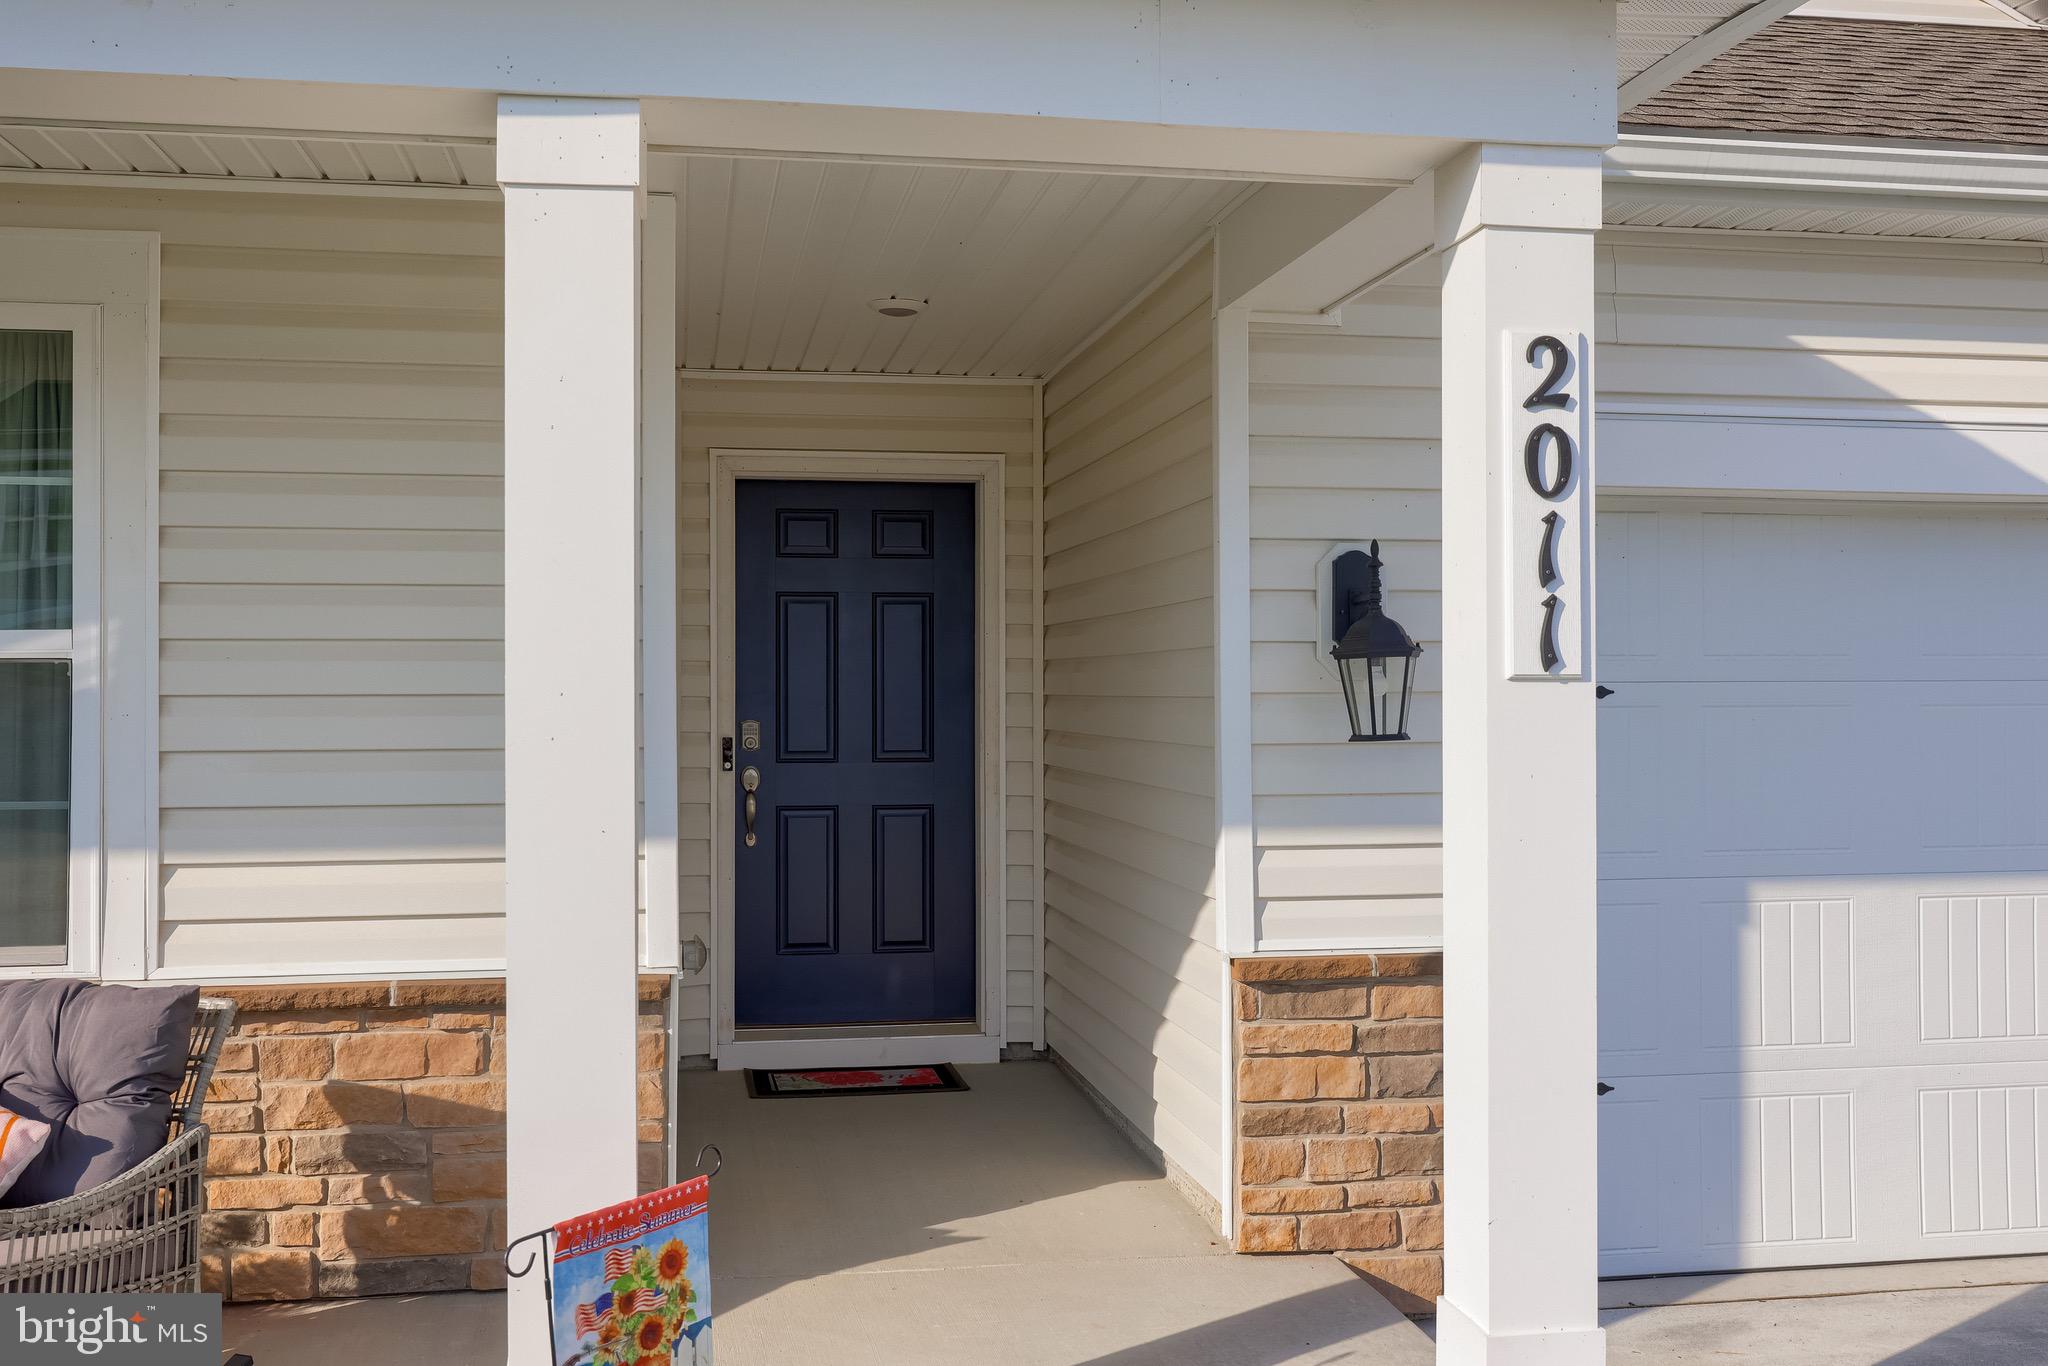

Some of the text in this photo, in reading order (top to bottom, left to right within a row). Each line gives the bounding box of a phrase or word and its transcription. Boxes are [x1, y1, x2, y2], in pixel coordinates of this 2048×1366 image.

[1522, 335, 1573, 673] 2011
[570, 1203, 696, 1255] Celebrate Summer
